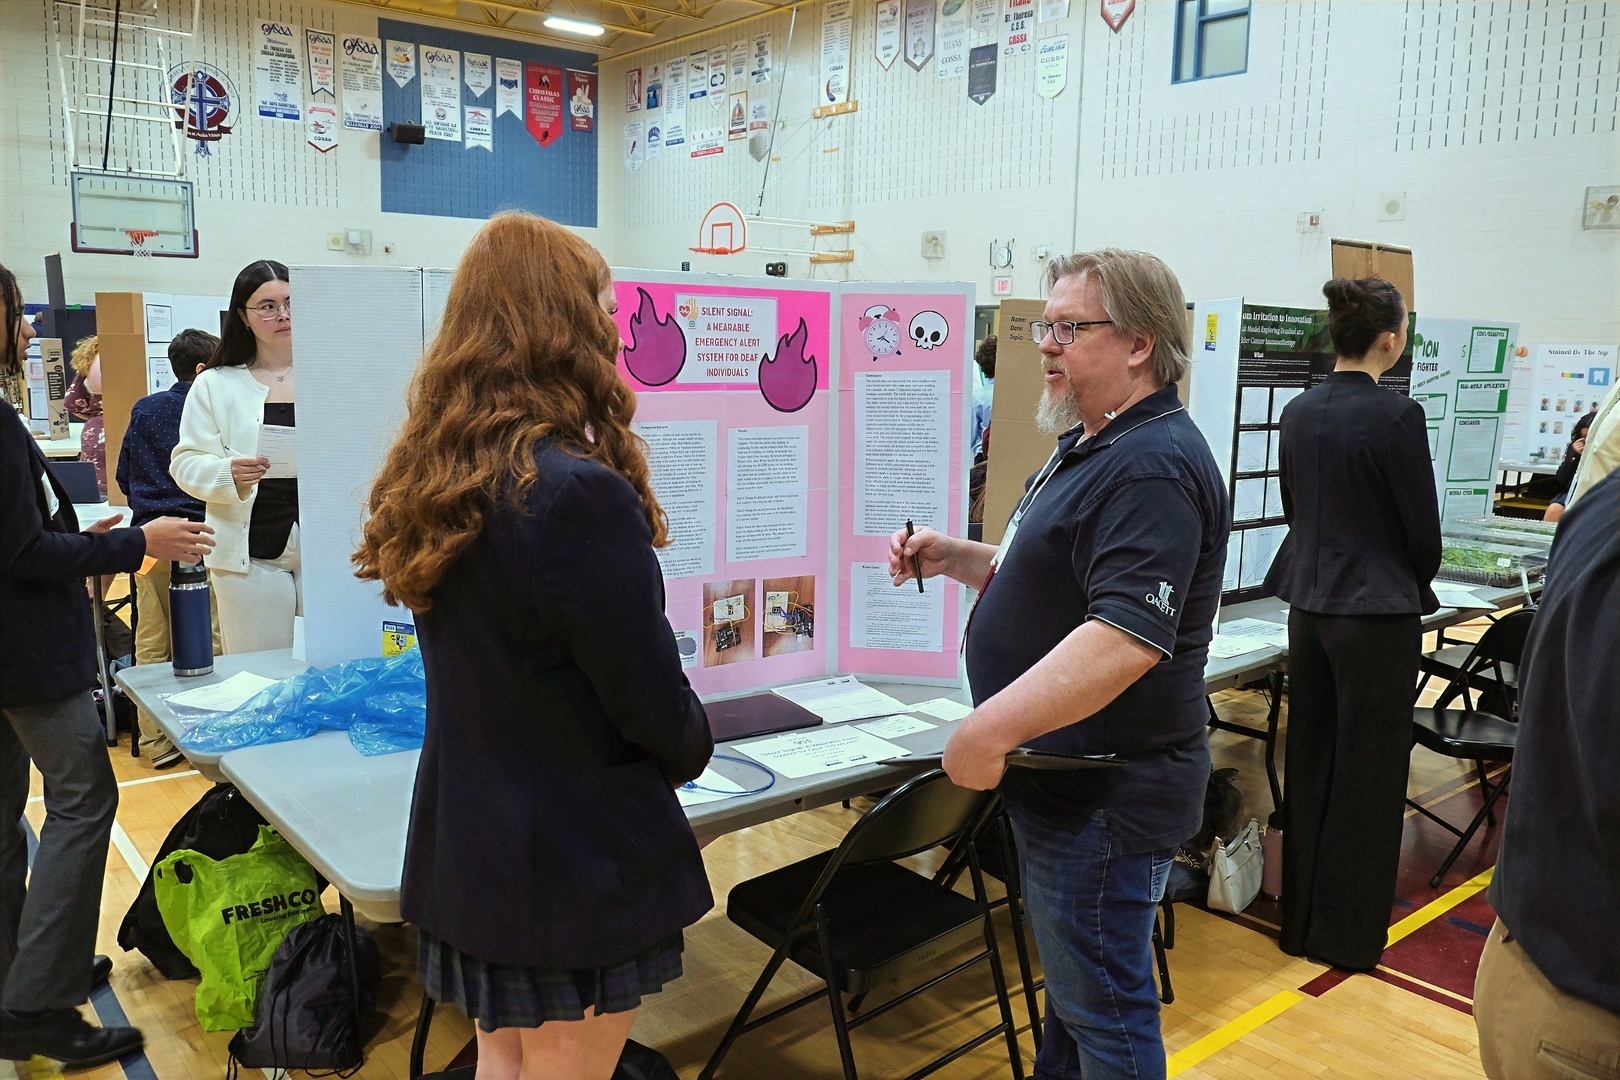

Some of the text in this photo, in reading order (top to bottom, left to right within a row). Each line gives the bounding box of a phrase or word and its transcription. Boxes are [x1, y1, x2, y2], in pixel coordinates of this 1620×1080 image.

[1013, 10, 1034, 20] Theresa
[1009, 33, 1028, 45] COSSA
[942, 54, 962, 64] COSSA
[1041, 55, 1064, 63] COSSA
[528, 88, 560, 97] CHRISTMAS
[533, 95, 555, 103] CLASSIC
[701, 307, 753, 317] SILENT SIGNAL:
[1280, 314, 1286, 322] to
[1286, 314, 1312, 324] Innovation
[706, 323, 750, 332] A WEARABLE
[1248, 325, 1261, 333] Model
[1261, 326, 1280, 335] Exploring
[695, 338, 760, 347] EMERGENCY ALERT
[1266, 338, 1296, 347] Immunotherapy
[1422, 340, 1439, 358] ION
[697, 353, 759, 362] SYSTEM FOR DEAF
[1416, 363, 1439, 372] FIGHTER
[706, 368, 749, 377] INDIVIDUALS
[260, 912, 287, 923] Lowering
[287, 909, 300, 917] food
